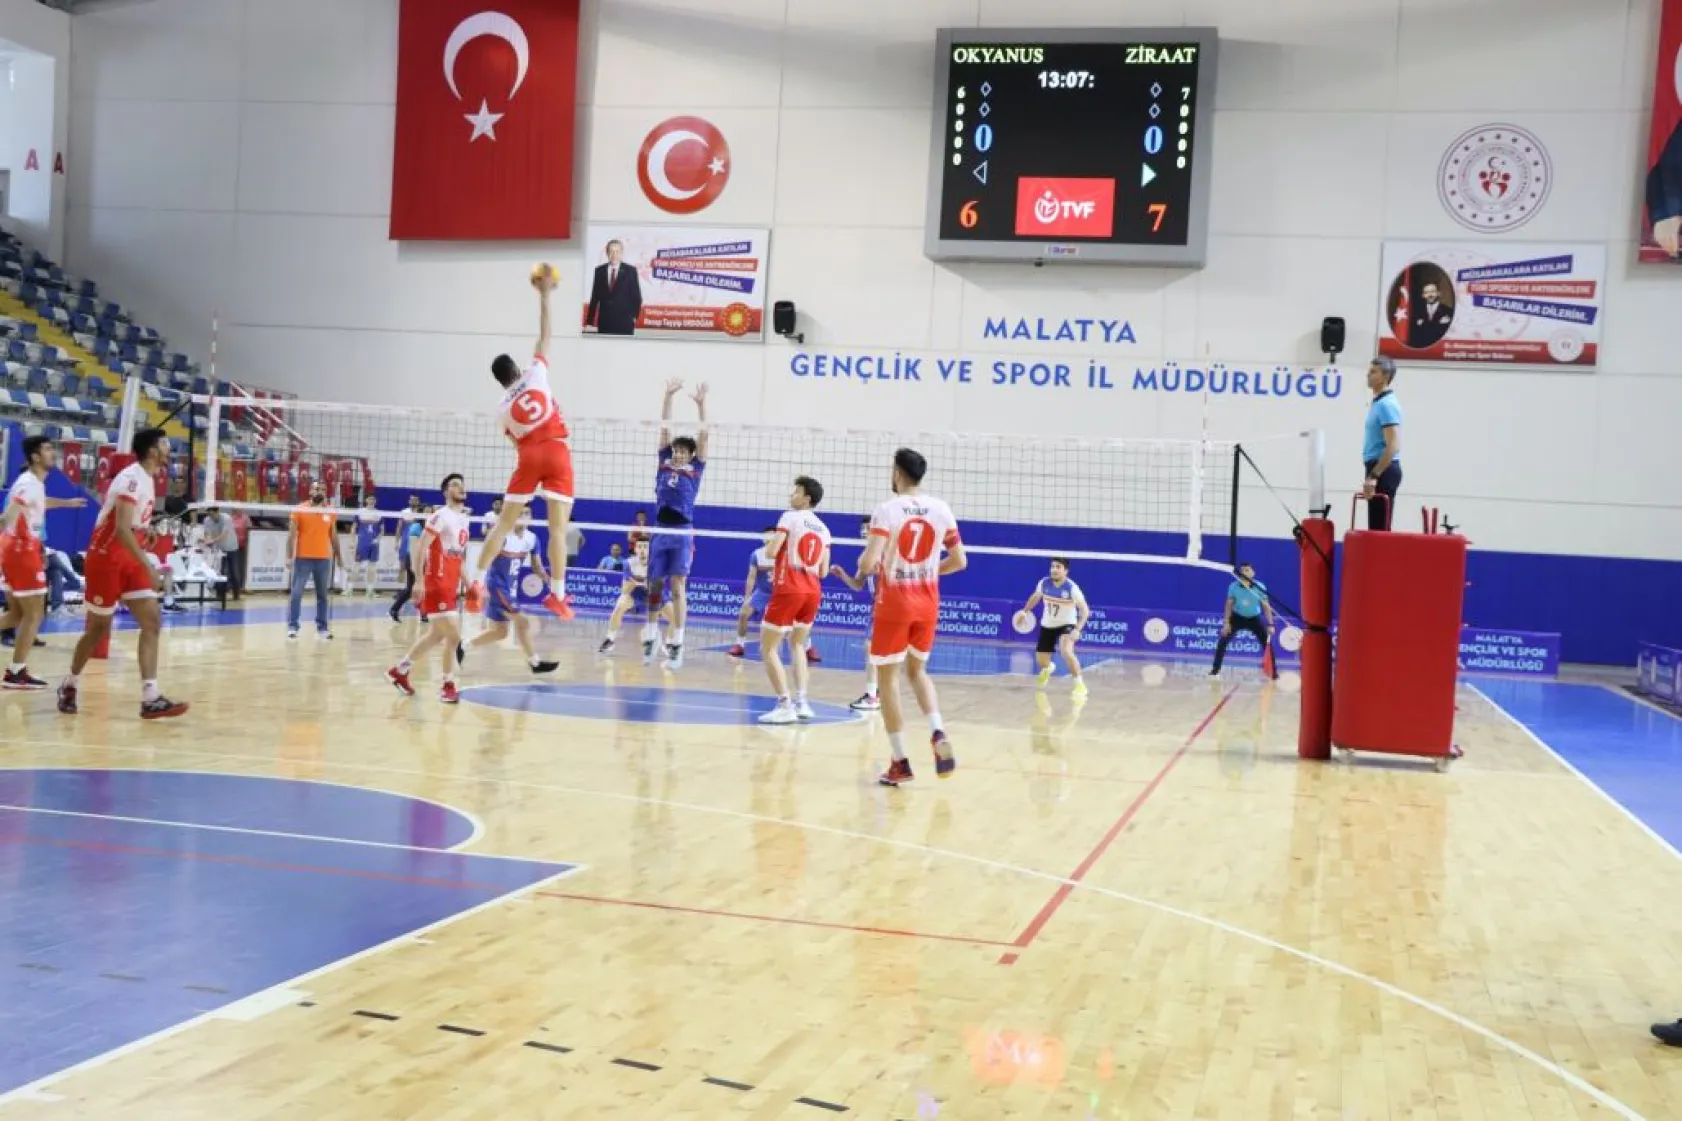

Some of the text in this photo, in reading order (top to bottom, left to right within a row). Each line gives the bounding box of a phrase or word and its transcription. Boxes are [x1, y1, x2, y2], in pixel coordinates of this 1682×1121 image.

[953, 47, 1044, 65] OKYANUS
[1125, 44, 1196, 65] ZİRAAT
[1038, 71, 1095, 88] 13:07:
[957, 87, 966, 99] 6
[1181, 87, 1191, 100] 7
[955, 103, 965, 115] 0
[1180, 104, 1190, 117] 0
[954, 120, 964, 132] 0
[1178, 121, 1188, 134] 0
[953, 136, 963, 149] 0
[974, 124, 993, 151] 0
[1144, 125, 1163, 154] 0
[1177, 139, 1187, 152] 0
[24, 148, 39, 170] A
[53, 152, 64, 174] A
[952, 153, 962, 166] 0
[1176, 156, 1186, 169] 0
[959, 200, 979, 228] 6
[1060, 201, 1095, 219] TVF
[1148, 204, 1167, 232] 7
[984, 316, 1137, 344] MALATYA
[790, 353, 1343, 399] GENÇLİK VE SPOR İL MÜDÜRLÜĞÜ
[517, 393, 542, 421] 5
[568, 573, 607, 582] MALATYA
[689, 581, 729, 591] MALATYA
[962, 611, 974, 621] VE
[975, 613, 1002, 622] SPOR
[1100, 621, 1128, 631] SPOR
[1173, 625, 1219, 638] GENÇLİK
[1475, 634, 1522, 644] MALATYA
[1458, 643, 1548, 657] ENÇLİK VE SPOR
